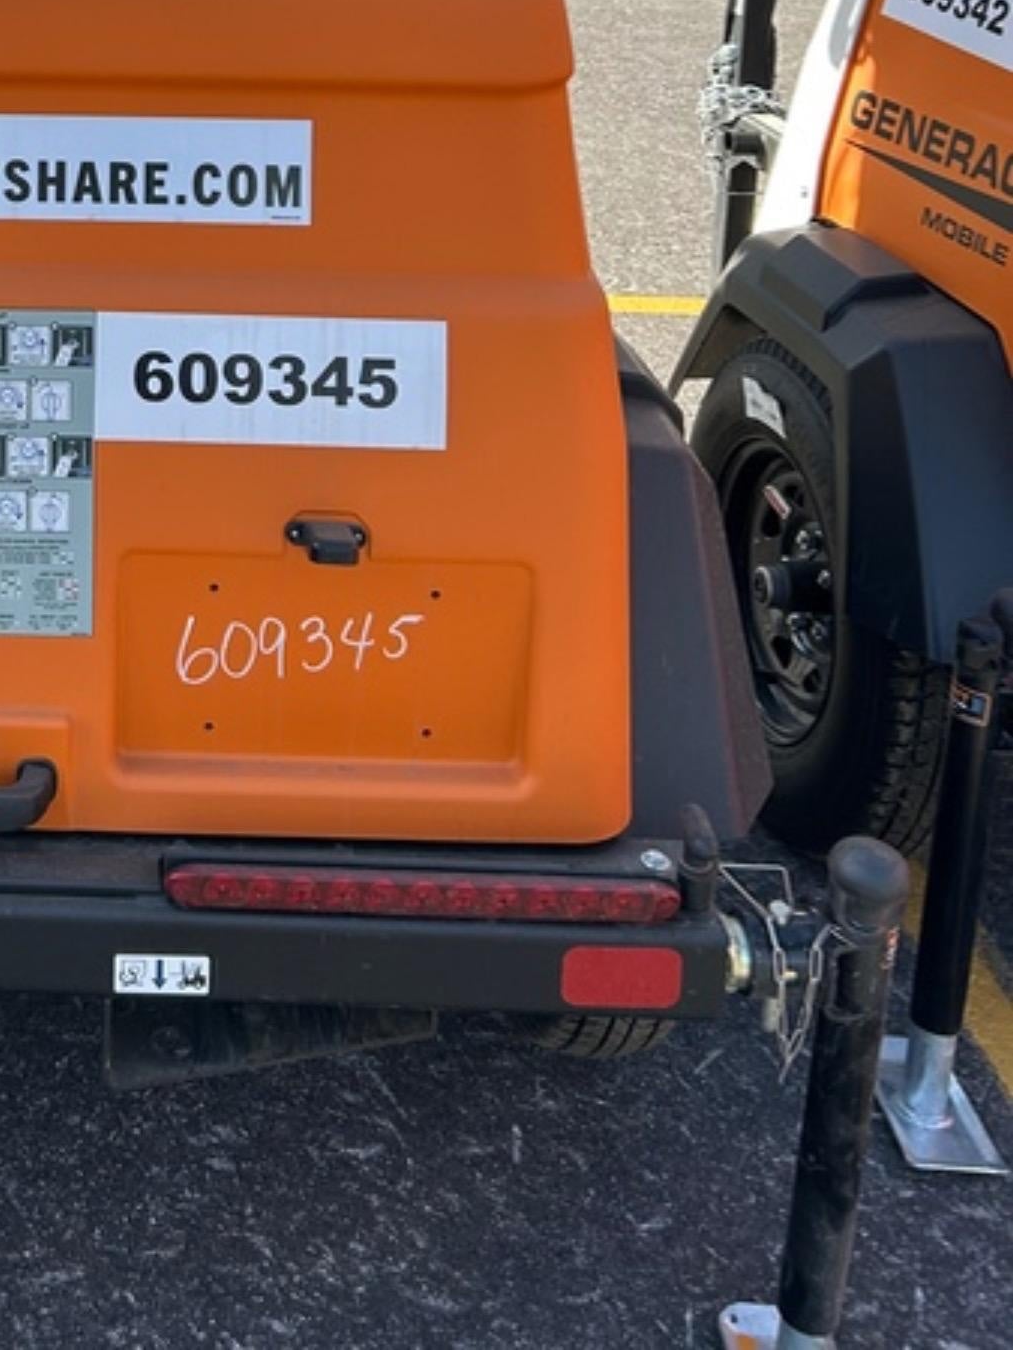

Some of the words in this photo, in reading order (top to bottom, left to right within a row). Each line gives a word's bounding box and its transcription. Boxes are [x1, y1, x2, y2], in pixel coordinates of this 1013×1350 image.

[920, 206, 1011, 266] MOBILE
[133, 351, 398, 409] 609345
[175, 611, 427, 686] 609345
